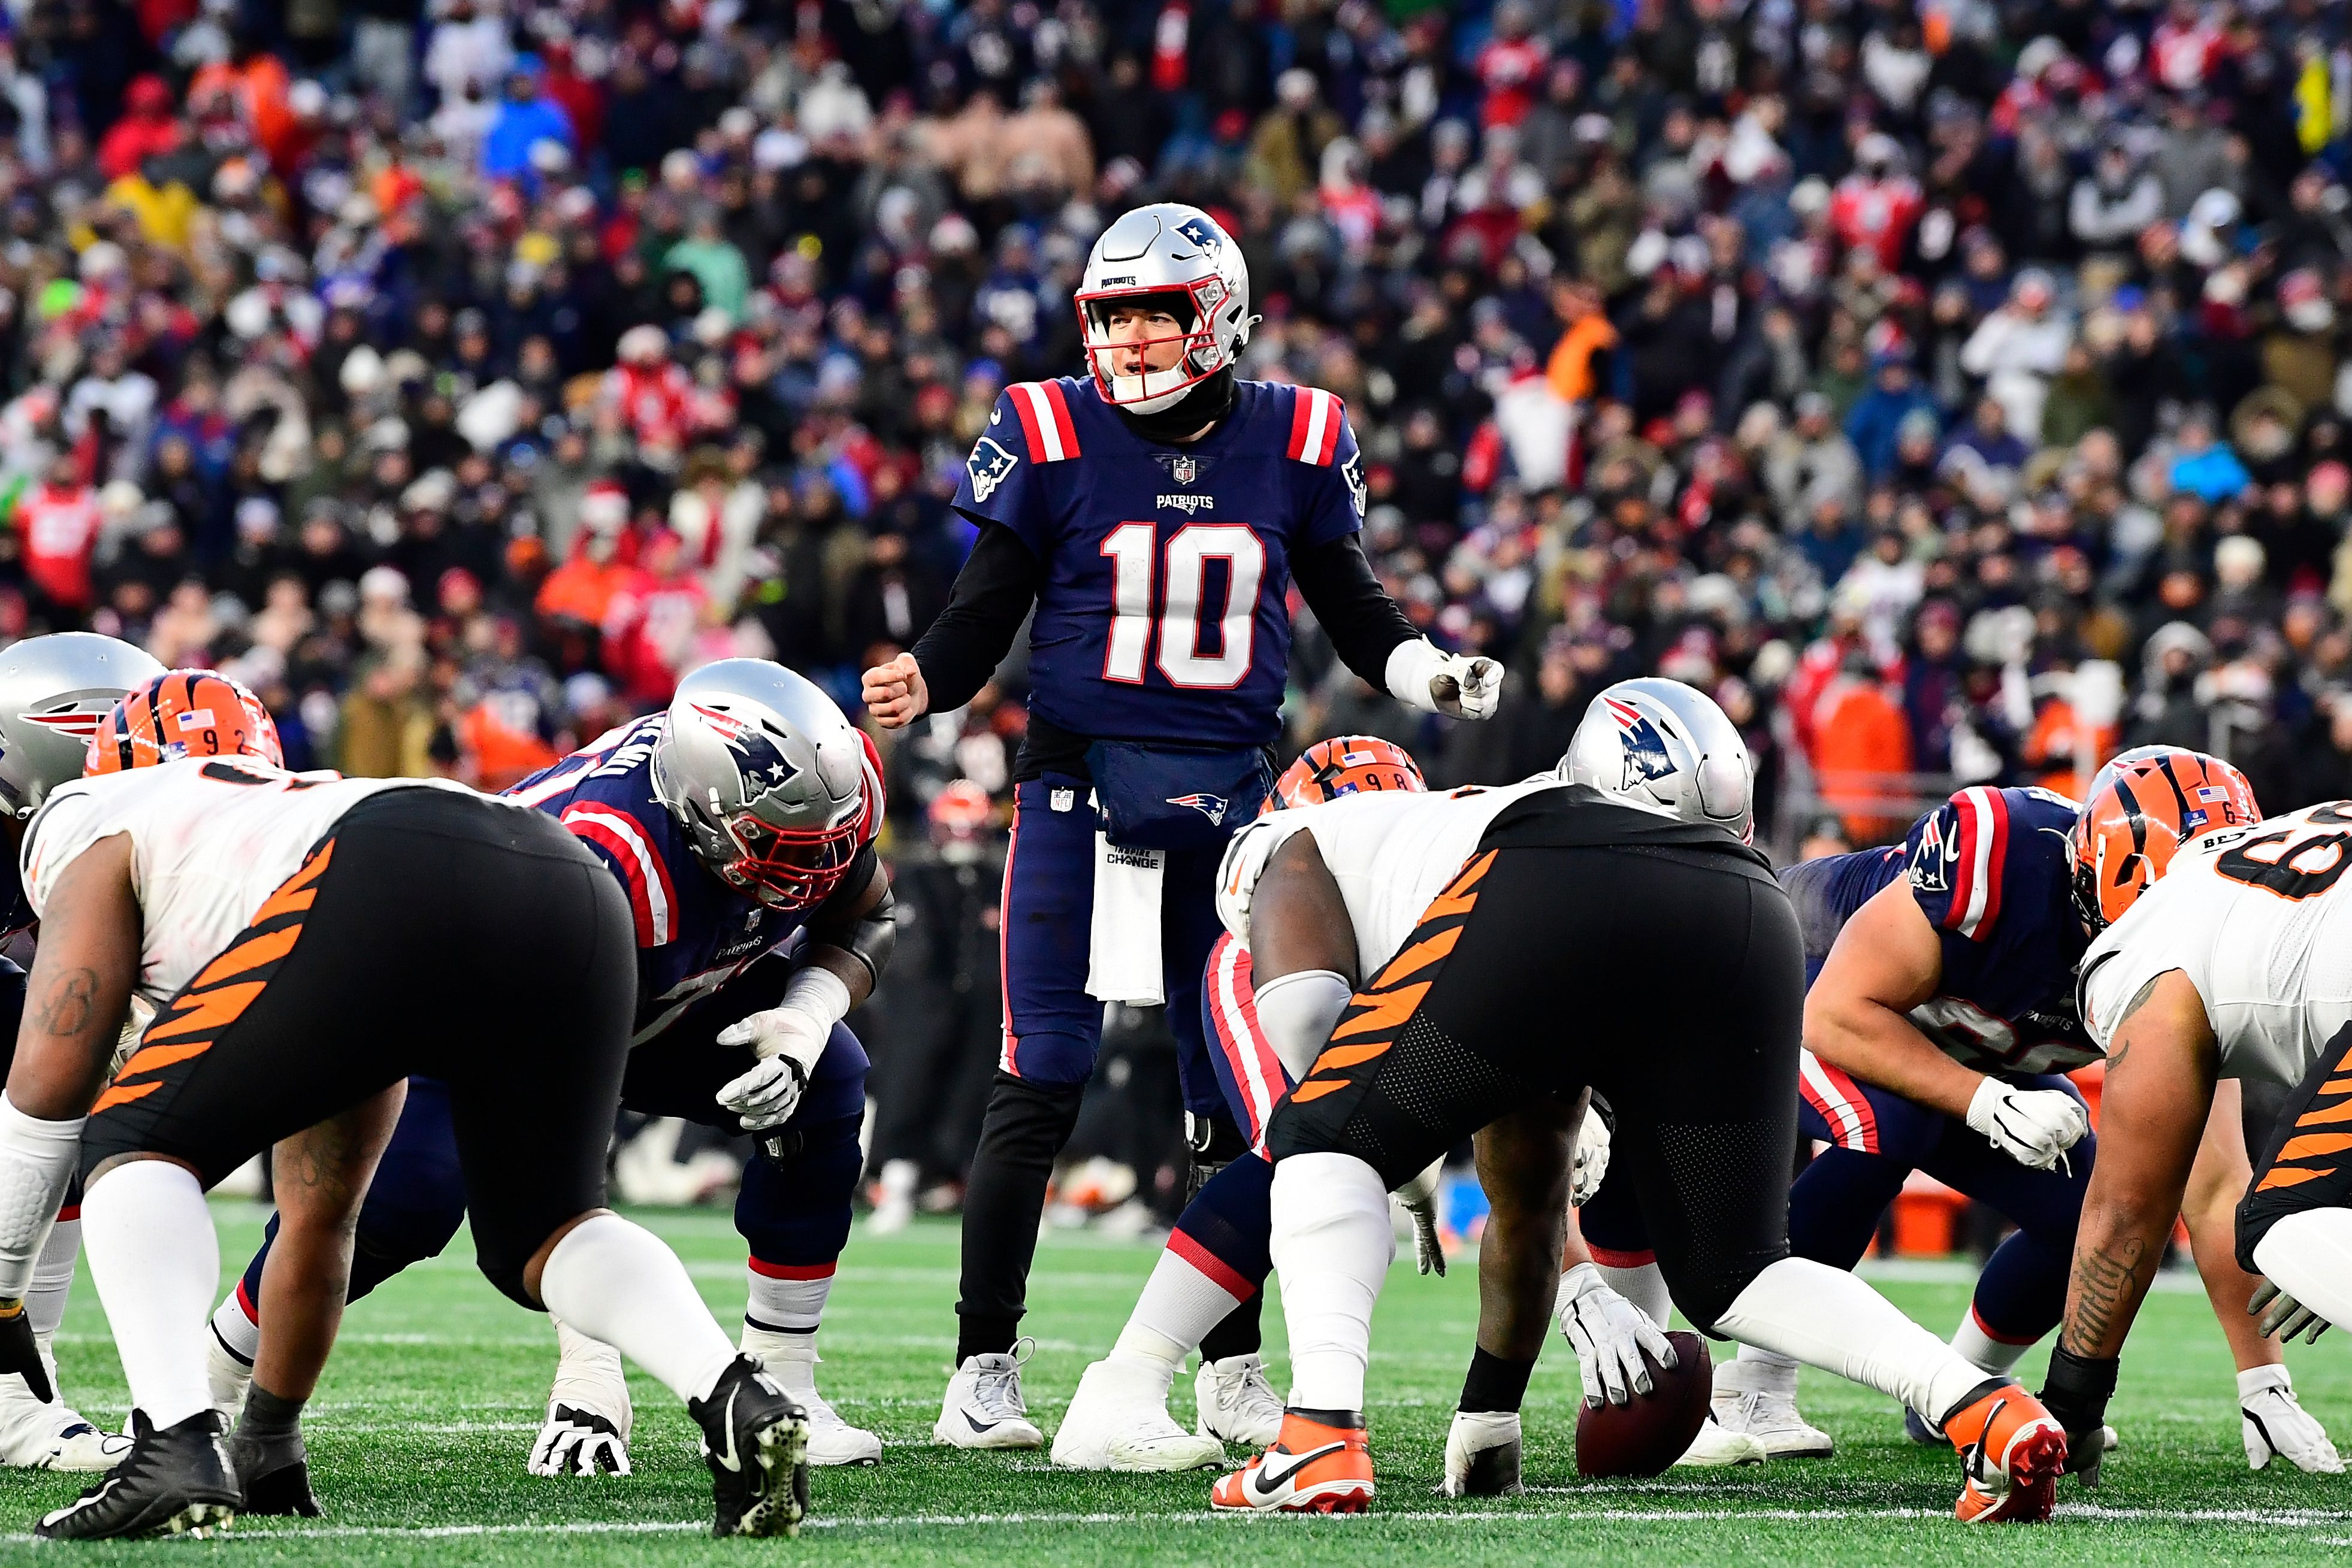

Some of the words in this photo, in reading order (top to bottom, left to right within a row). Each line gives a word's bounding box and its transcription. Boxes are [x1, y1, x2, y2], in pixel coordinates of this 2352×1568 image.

[1177, 469, 1192, 480] NFL
[1156, 495, 1214, 509] PATRIOTS
[1099, 520, 1266, 689] 10
[203, 729, 249, 756] 92
[1055, 798, 1069, 809] NFL
[1107, 853, 1159, 870] CHANGE
